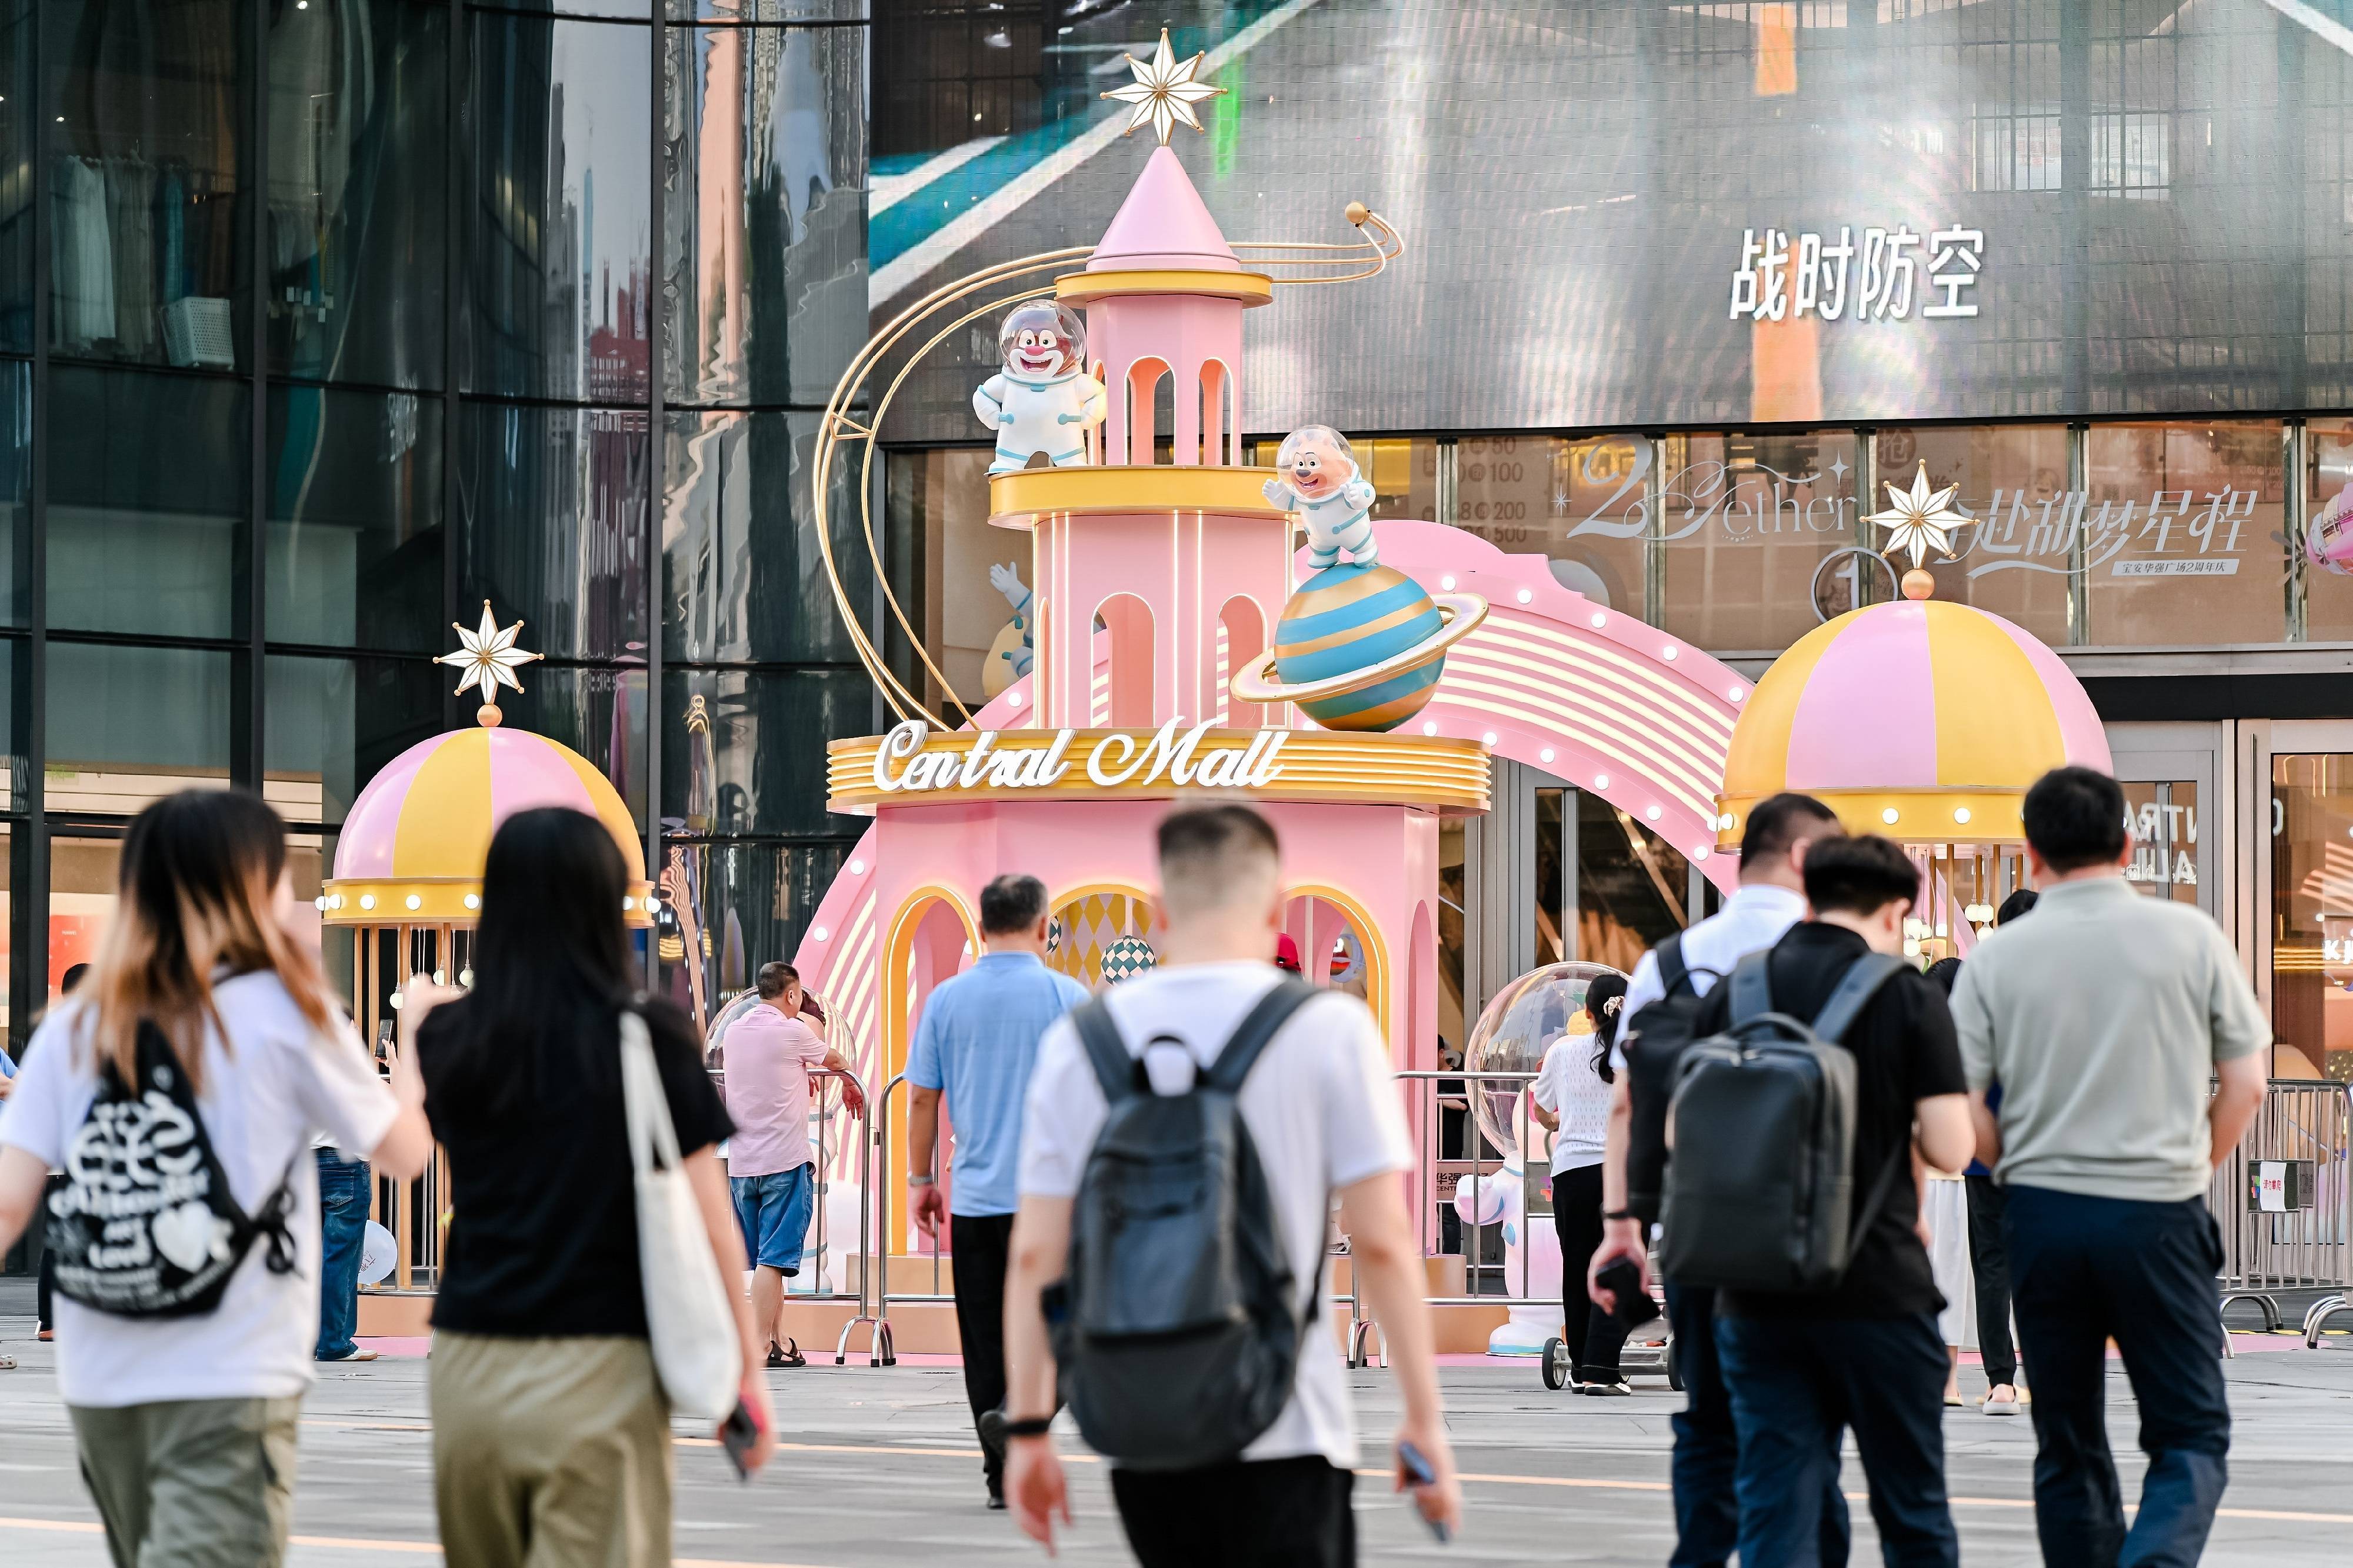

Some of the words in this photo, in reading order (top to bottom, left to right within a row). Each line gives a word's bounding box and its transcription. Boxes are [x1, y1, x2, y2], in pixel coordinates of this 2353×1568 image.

[1729, 223, 1984, 322] 战时防空
[1489, 462, 1523, 482] 100
[1494, 501, 1526, 520] 200
[2122, 562, 2227, 574] 宝安华强广场2周年庆
[872, 719, 1078, 792] Central
[1086, 715, 1291, 789] Mall
